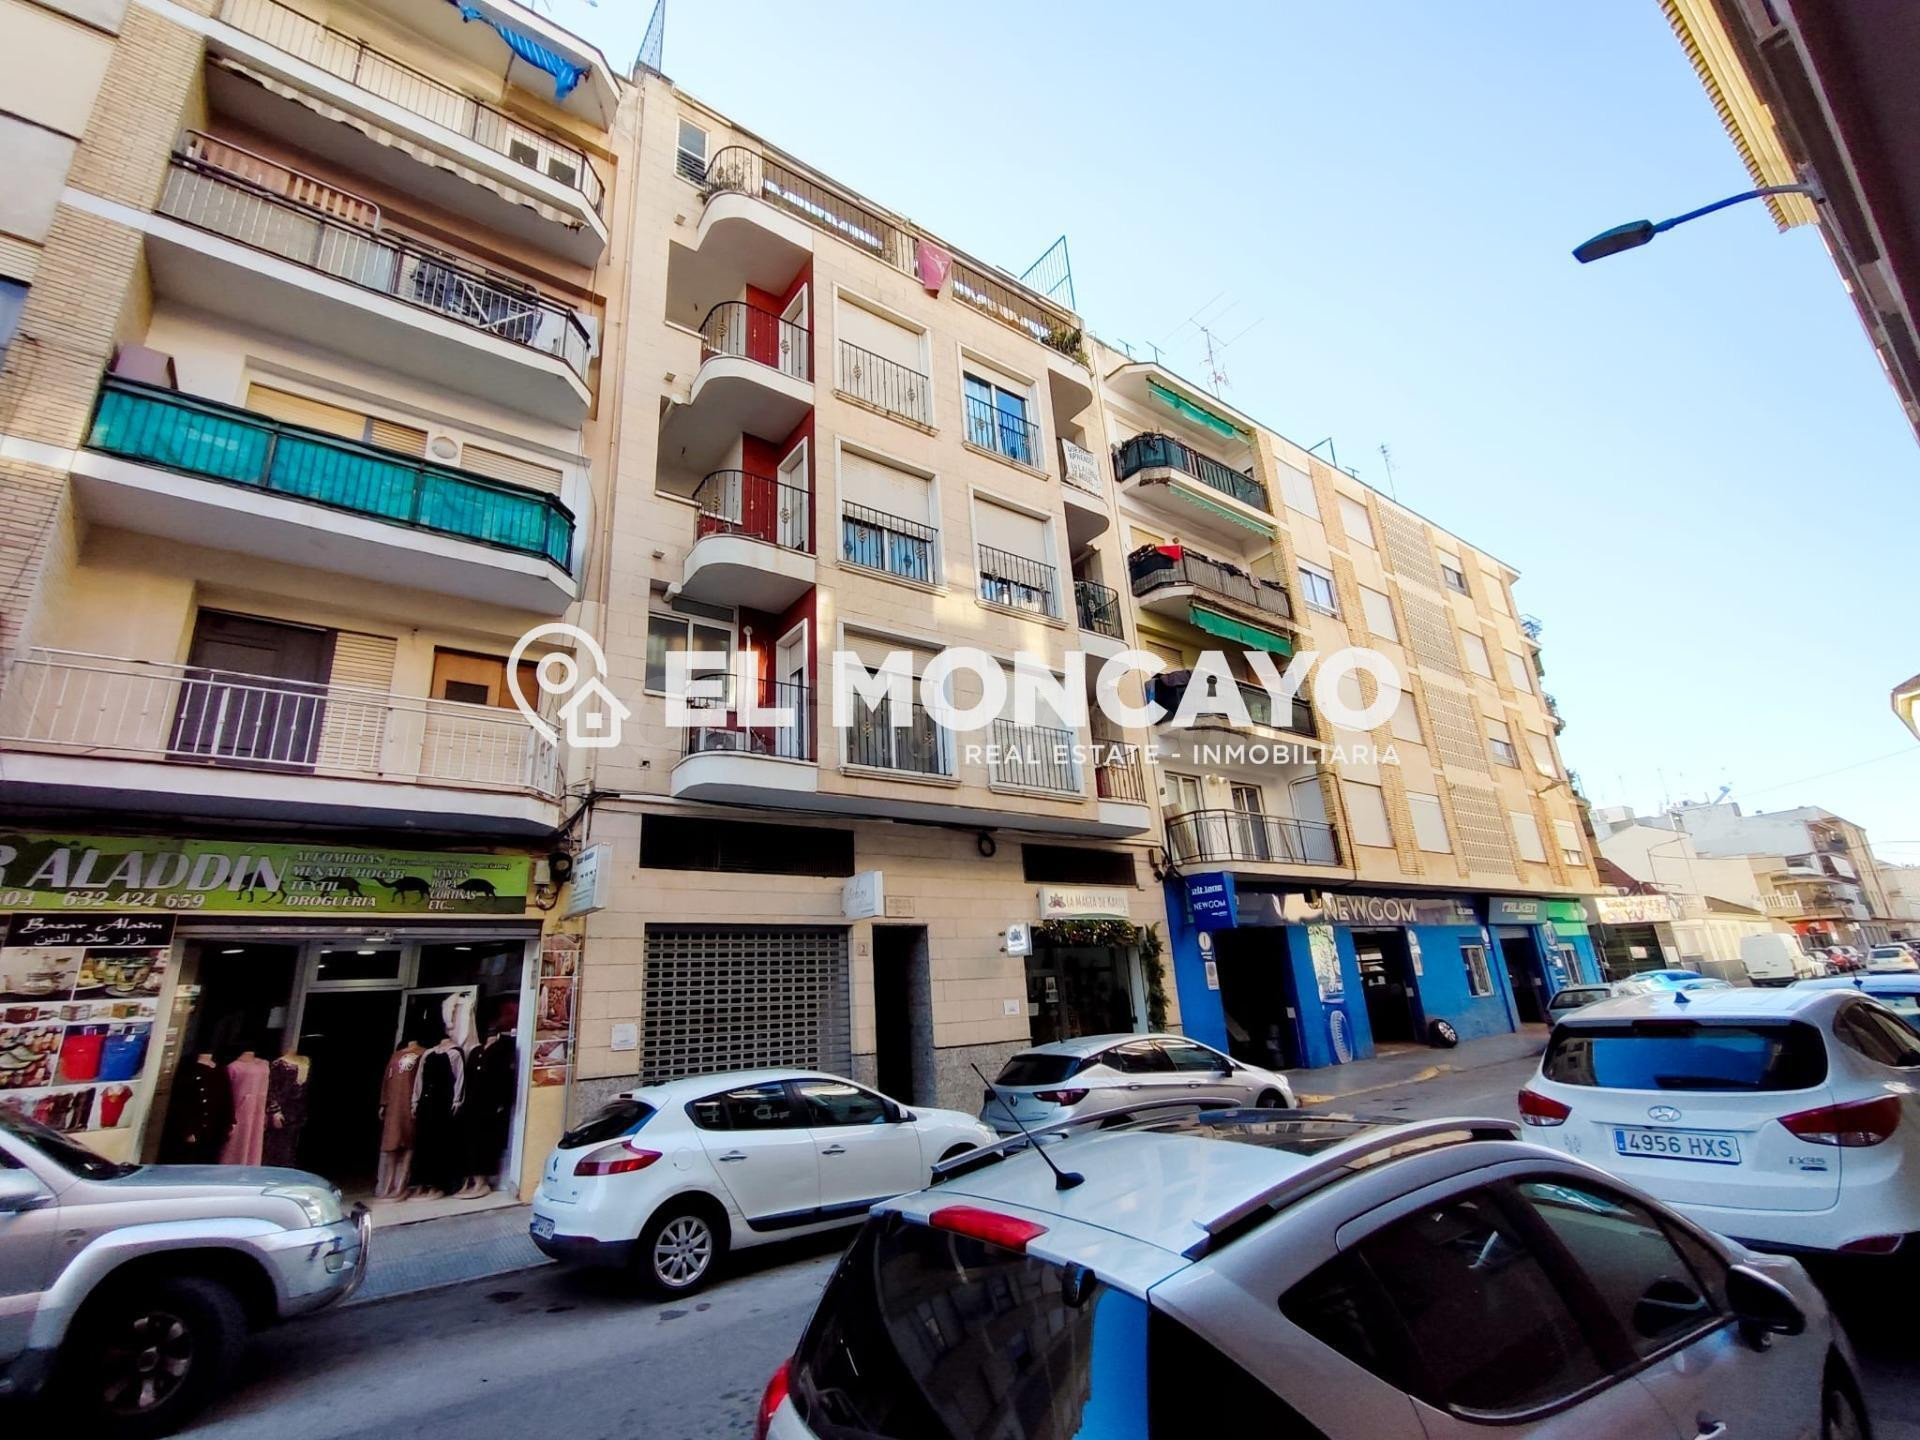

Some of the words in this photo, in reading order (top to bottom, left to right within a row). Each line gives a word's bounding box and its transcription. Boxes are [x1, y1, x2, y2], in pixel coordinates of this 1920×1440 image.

[25, 846, 289, 893] ALADDÍN
[291, 881, 340, 892] TEXTIL
[431, 879, 458, 889] ROPA
[63, 891, 108, 907] 632
[115, 892, 158, 907] 424
[165, 893, 205, 908] 659
[1193, 899, 1227, 911] NEWGOM
[1322, 897, 1417, 922] NEWGOM
[19, 917, 88, 934] Bazar
[1630, 1133, 1682, 1154] 4956
[1687, 1137, 1732, 1158] HXS
